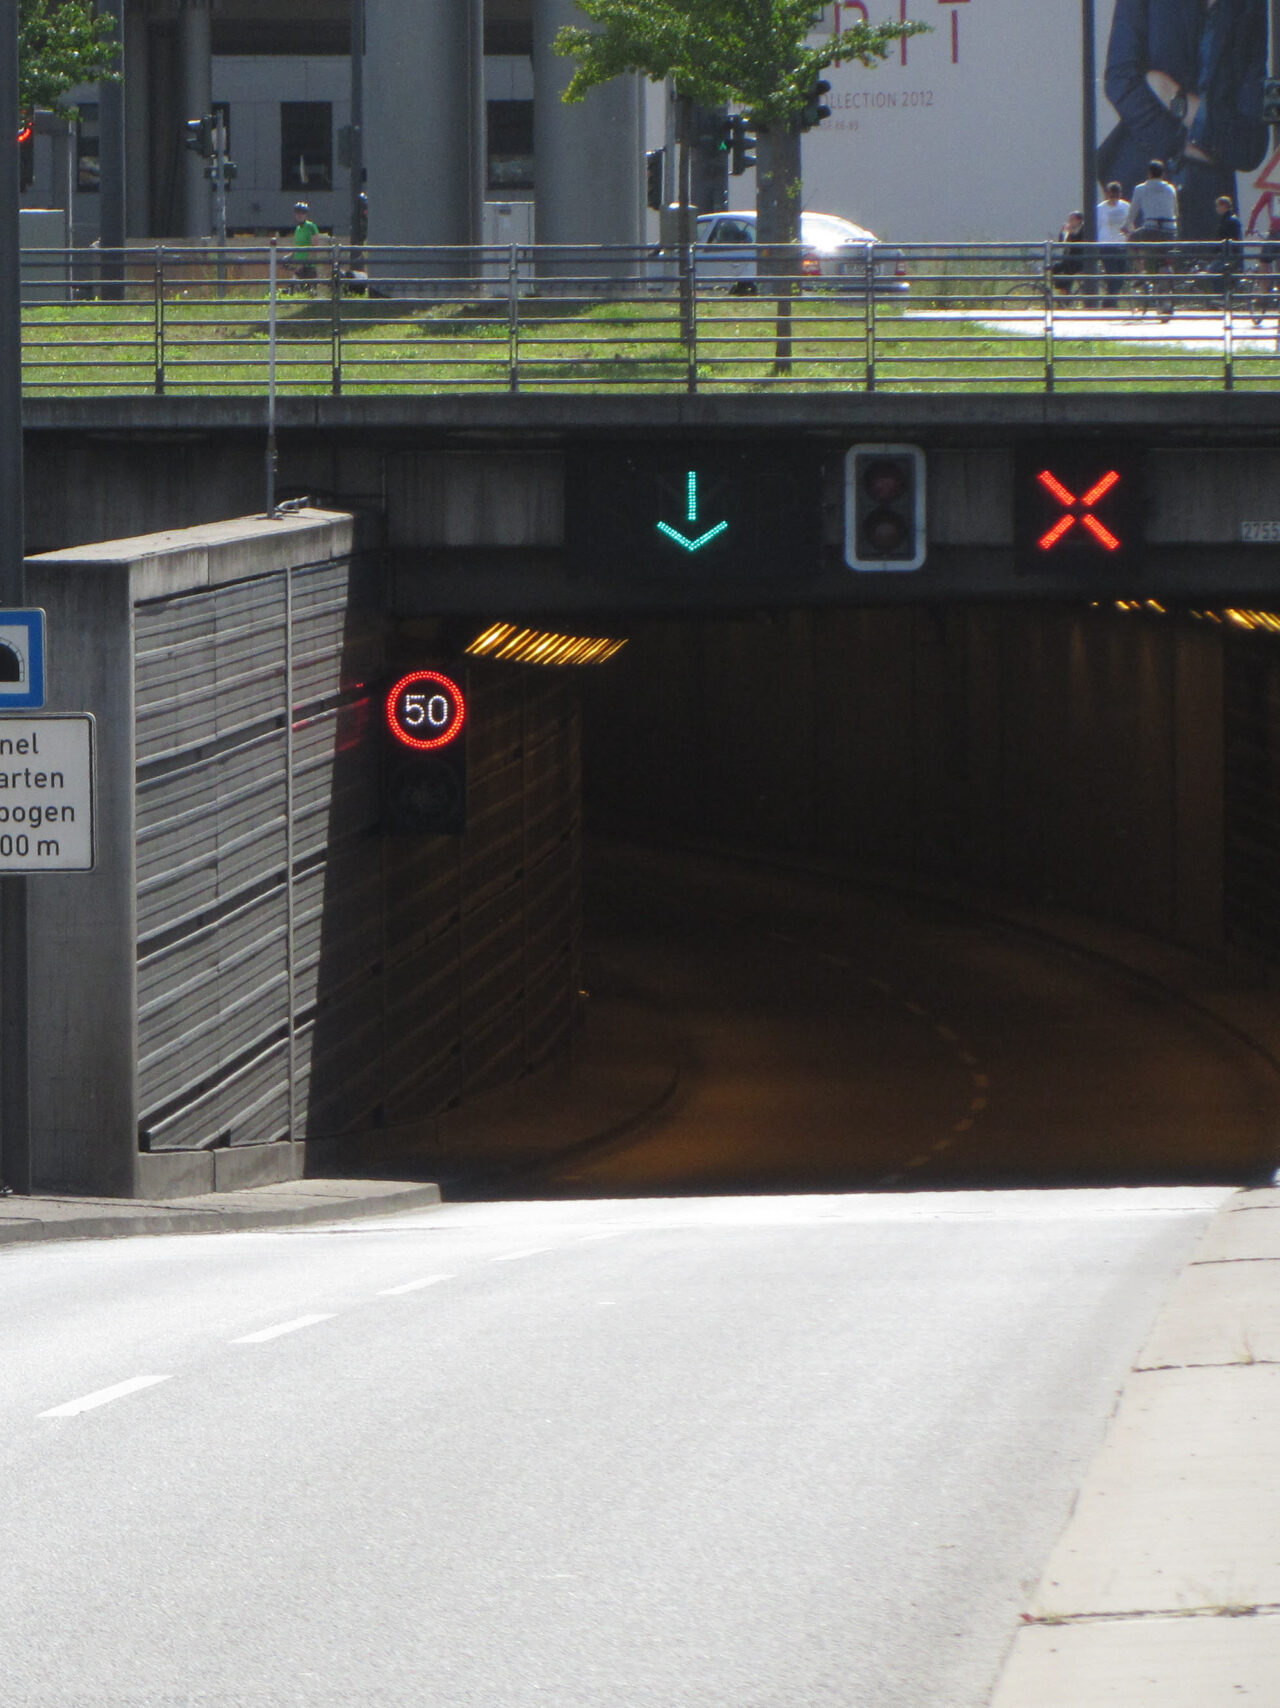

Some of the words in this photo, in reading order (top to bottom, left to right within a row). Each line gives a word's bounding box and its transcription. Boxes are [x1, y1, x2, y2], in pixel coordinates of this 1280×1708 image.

[819, 92, 897, 109] OLLECTION
[902, 90, 934, 107] 2012
[405, 694, 448, 725] 50
[37, 838, 60, 856] m
